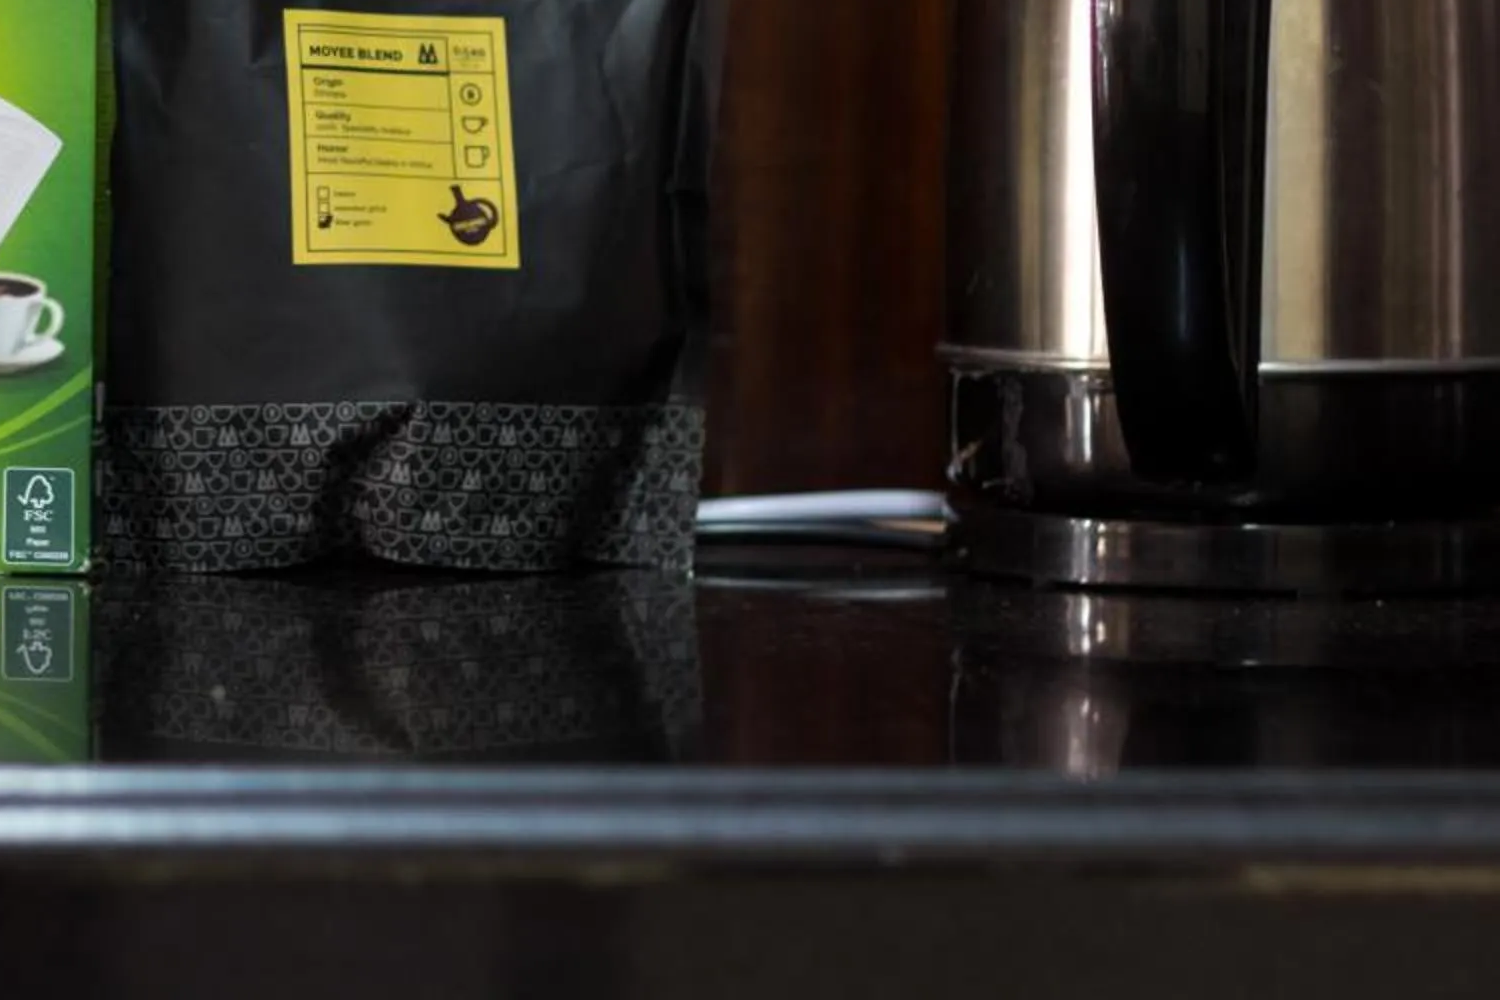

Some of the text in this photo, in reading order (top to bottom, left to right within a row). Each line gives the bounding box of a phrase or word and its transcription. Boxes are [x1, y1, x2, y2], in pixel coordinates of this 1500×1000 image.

[309, 45, 404, 62] MOYEE BLEND
[23, 508, 54, 522] FSC
